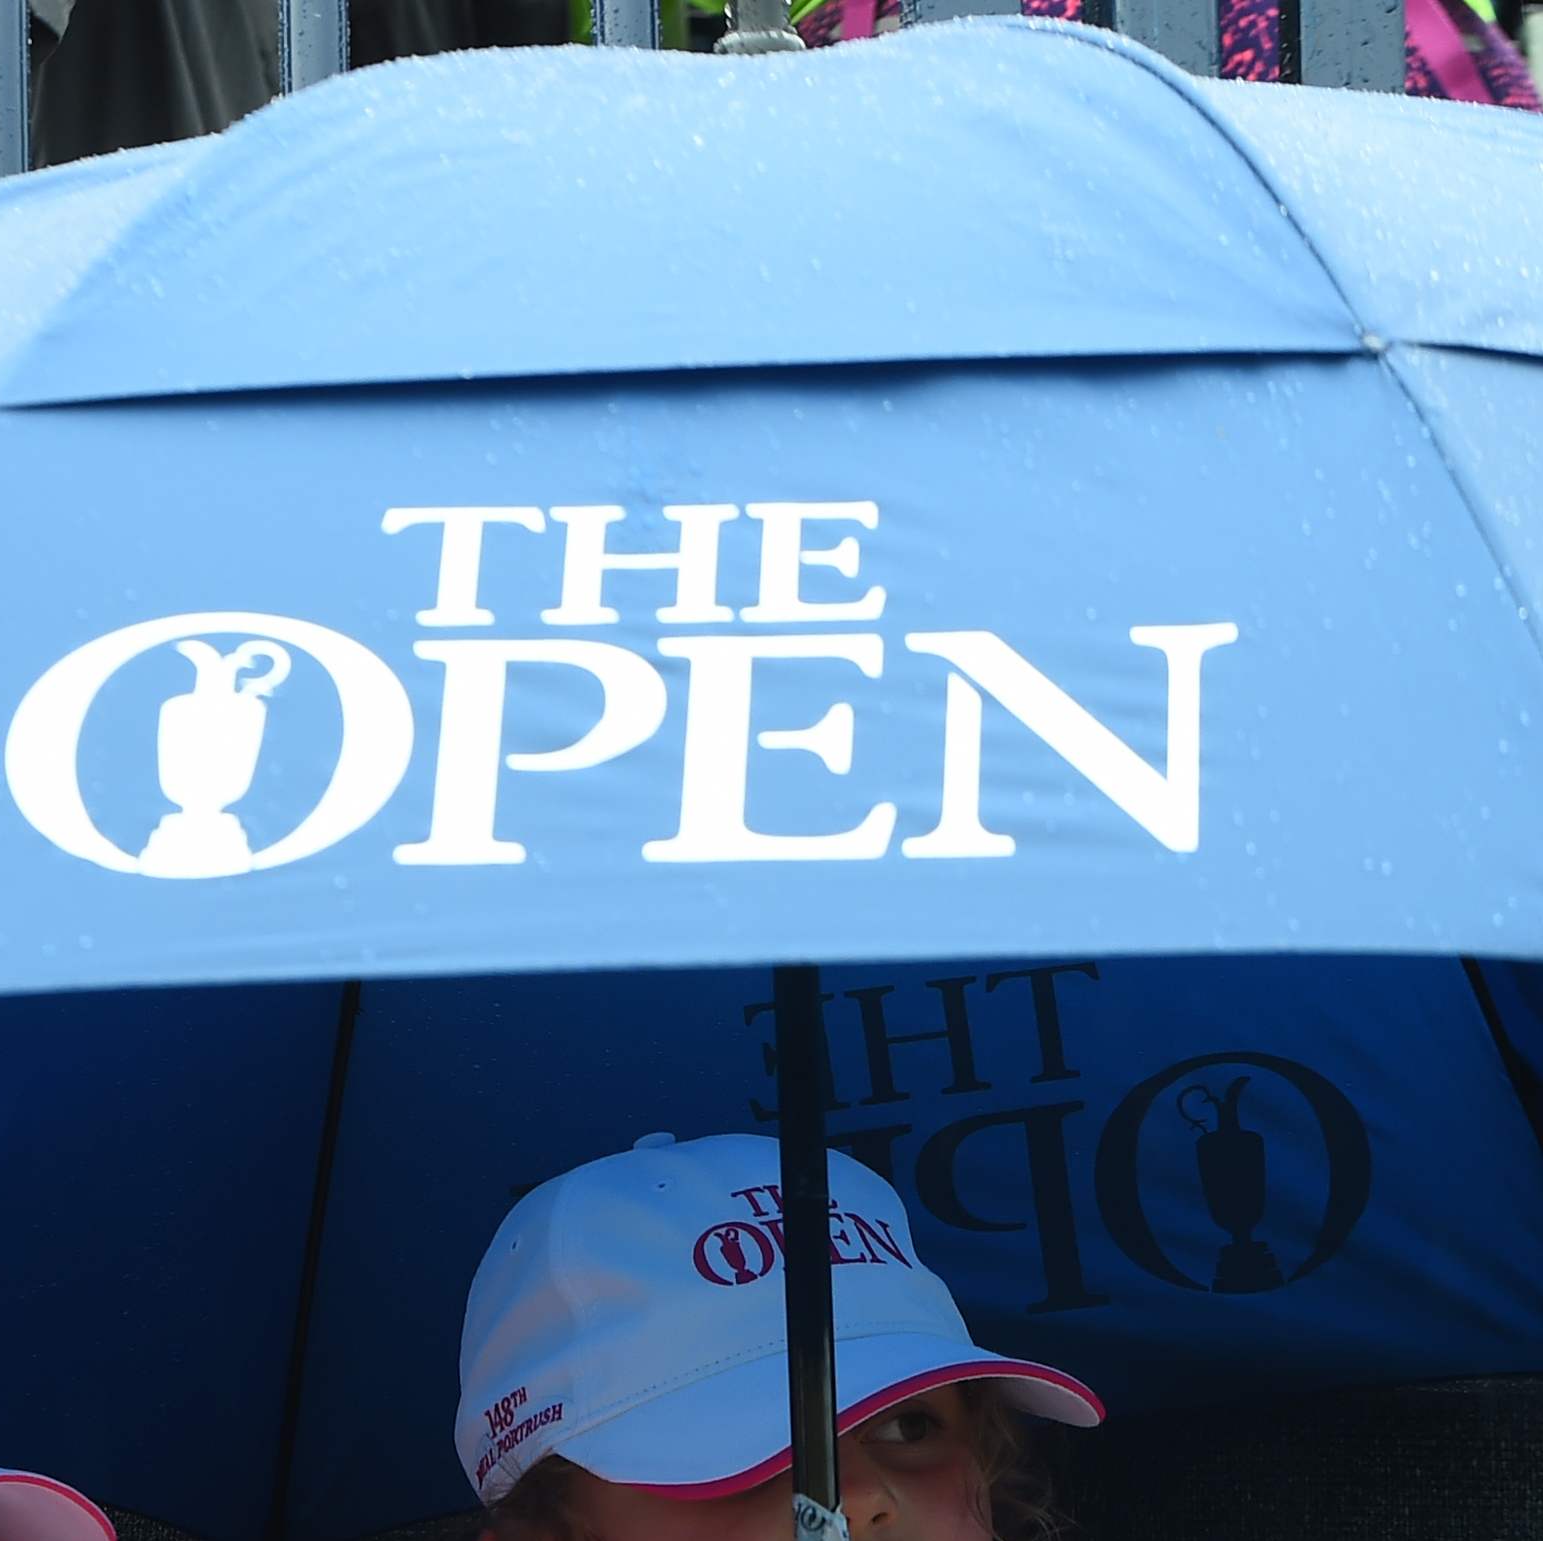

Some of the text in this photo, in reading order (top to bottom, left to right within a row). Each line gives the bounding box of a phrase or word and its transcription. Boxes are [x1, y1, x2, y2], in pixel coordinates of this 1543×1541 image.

[381, 500, 886, 626] THE
[4, 610, 1239, 879] OPEN
[693, 1211, 913, 1286] OEN
[484, 1386, 527, 1439] 148TH
[496, 1402, 563, 1459] PORTRUSH
